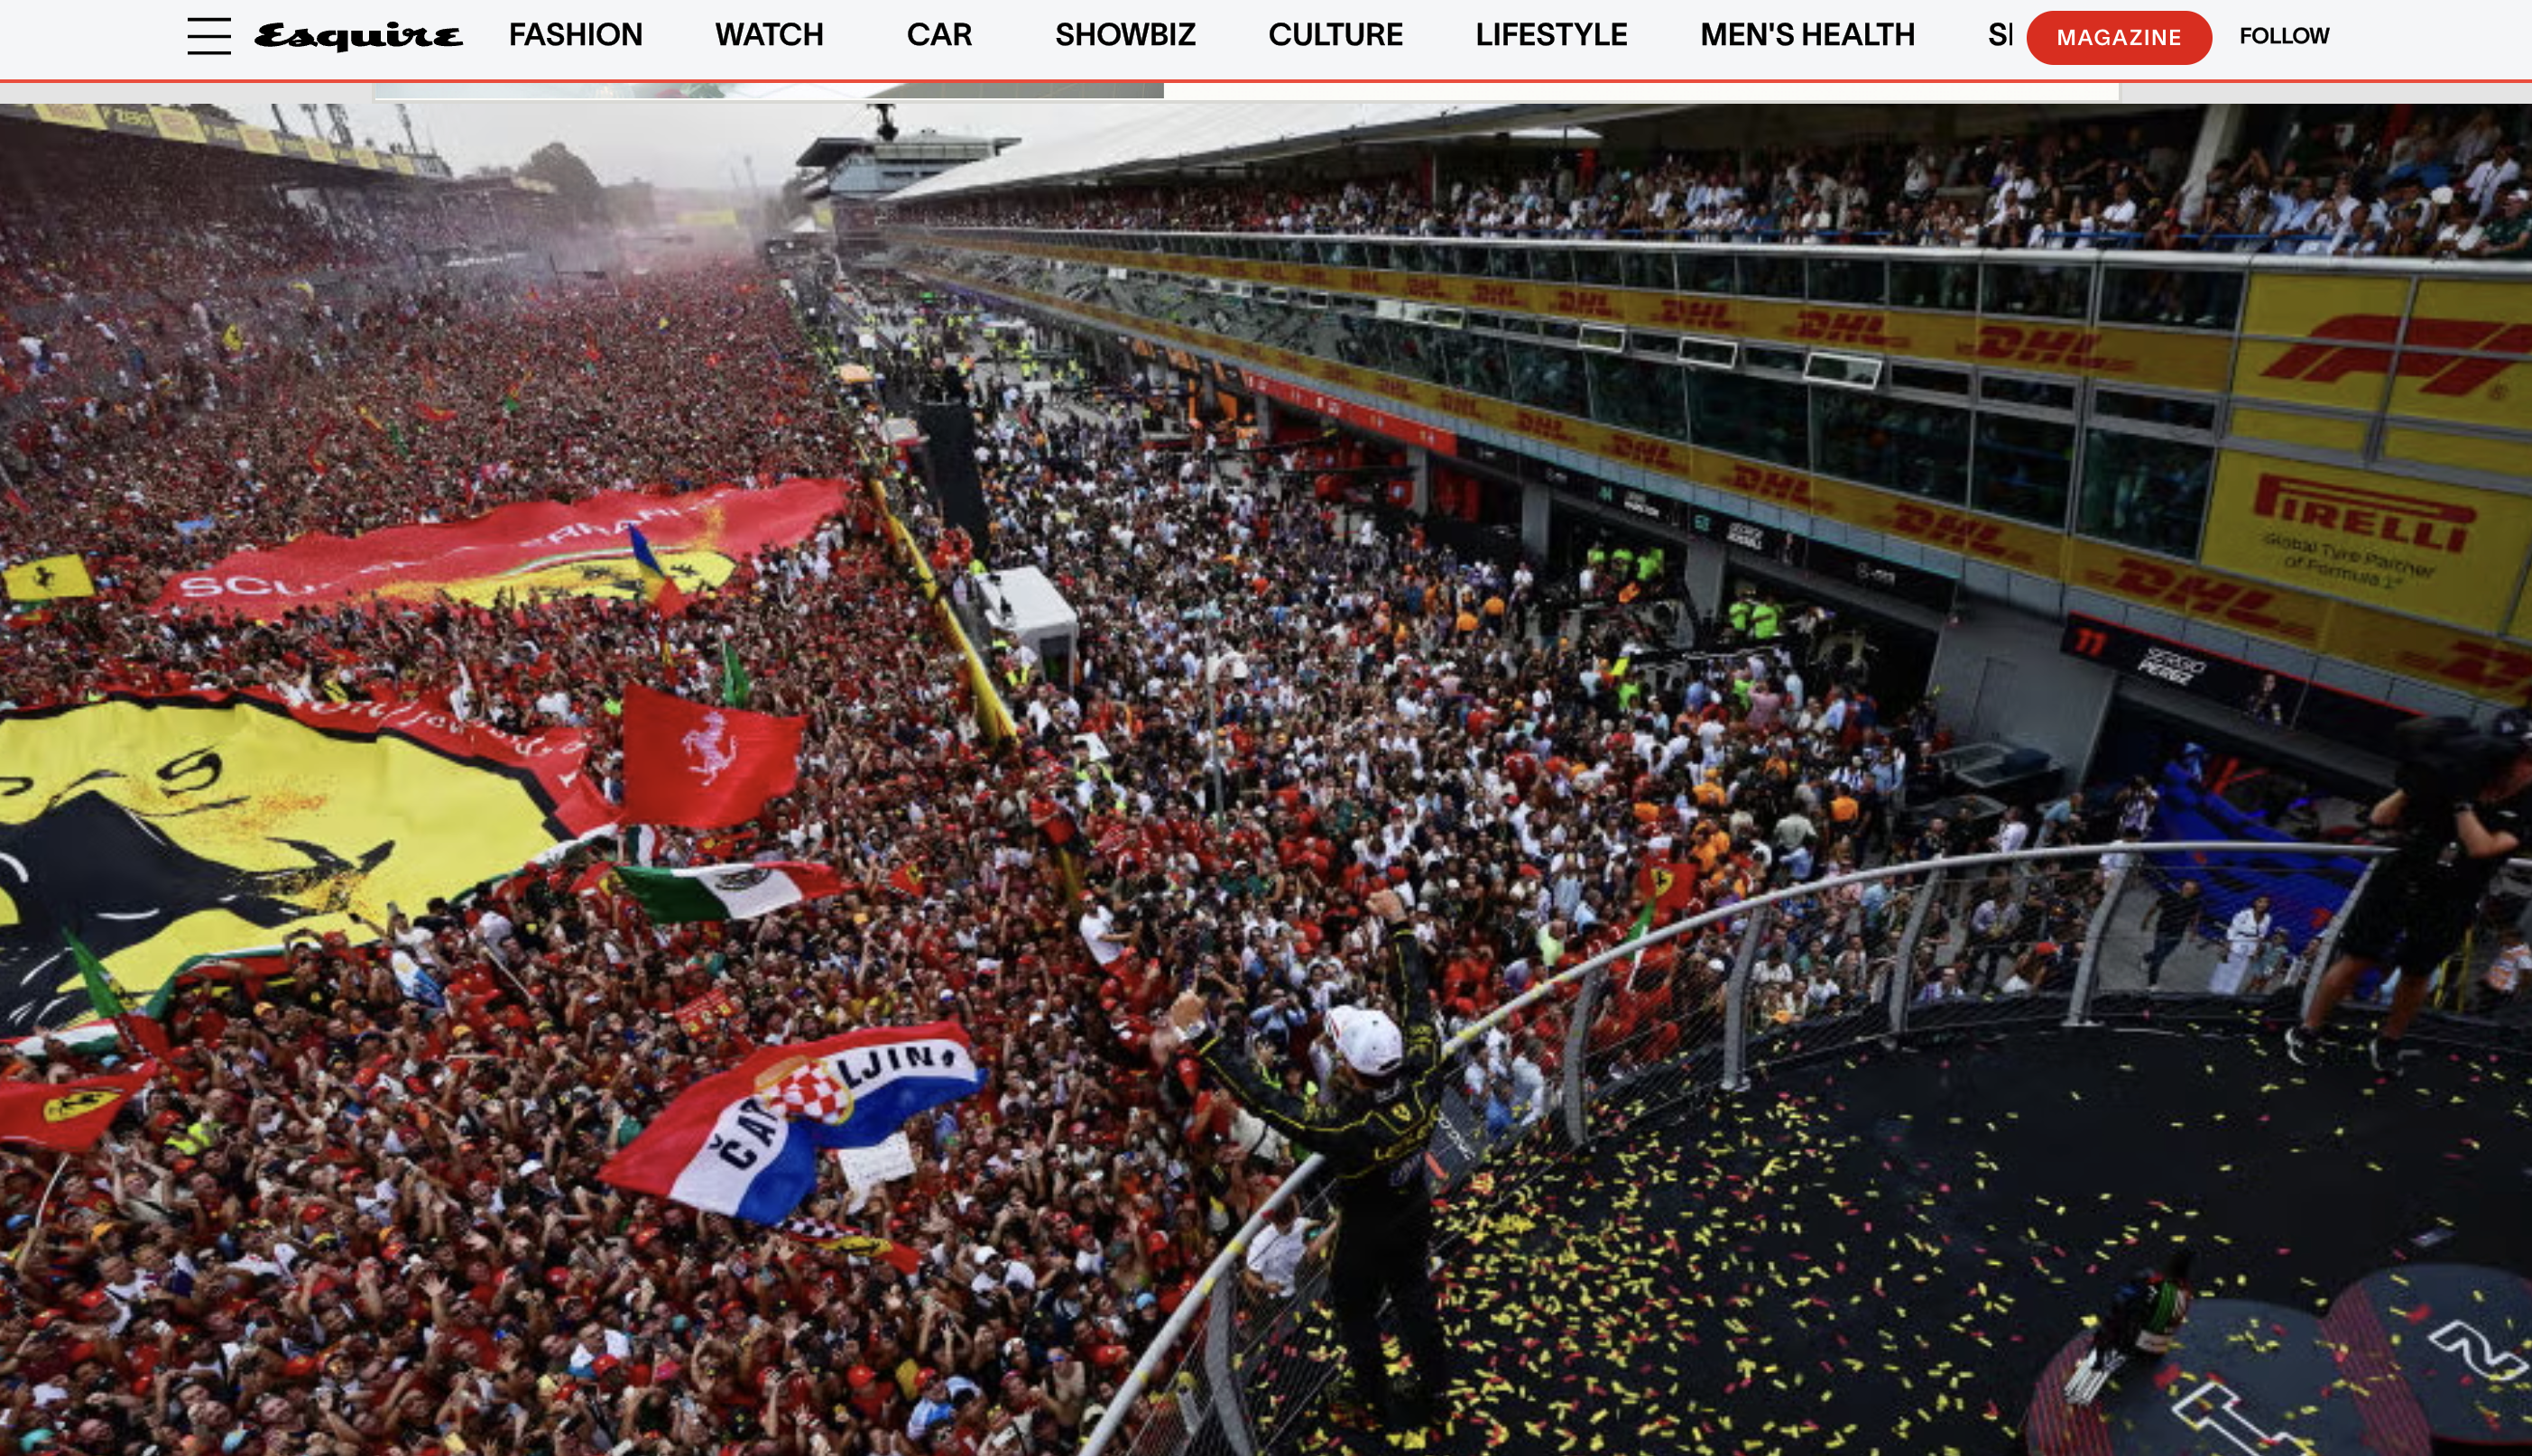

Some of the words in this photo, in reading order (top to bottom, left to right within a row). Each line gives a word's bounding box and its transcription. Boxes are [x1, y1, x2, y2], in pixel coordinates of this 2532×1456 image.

[1658, 299, 1731, 329] DHL
[1793, 309, 1887, 348] DHL
[1974, 325, 2104, 371] DHL
[1728, 463, 1817, 510] DHL
[1889, 502, 2010, 560] DHL
[2253, 472, 2478, 554] PIRELLI
[2262, 532, 2318, 553] Global
[2322, 543, 2362, 564] Tyre
[2365, 551, 2437, 578] Partner
[2306, 559, 2380, 586] Formula
[2112, 557, 2283, 631] DHL
